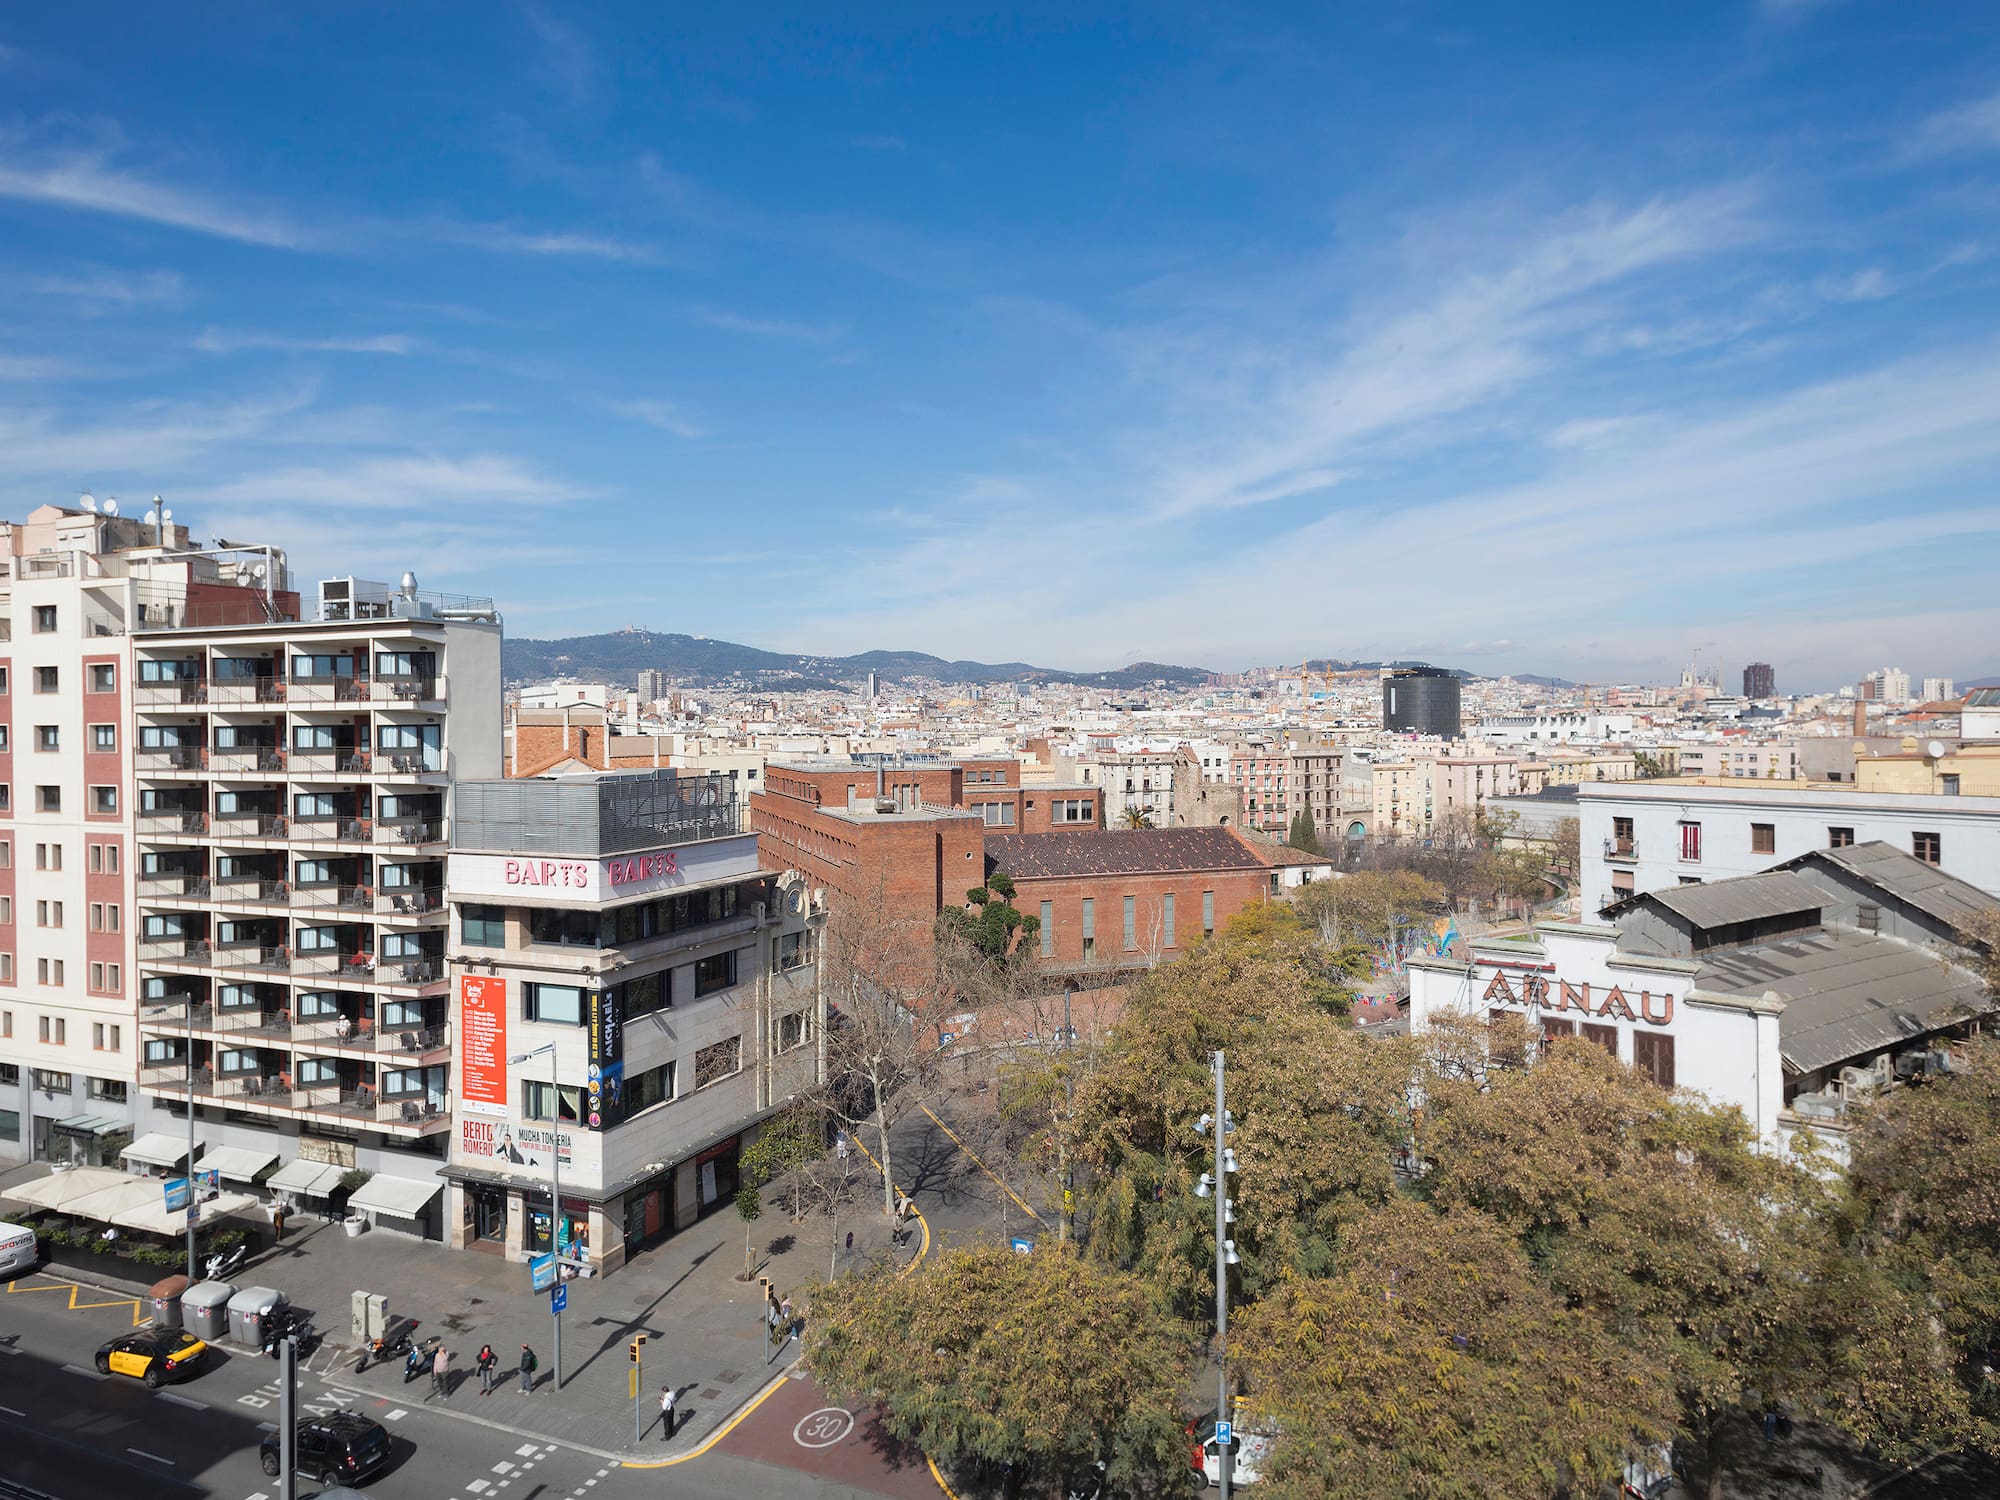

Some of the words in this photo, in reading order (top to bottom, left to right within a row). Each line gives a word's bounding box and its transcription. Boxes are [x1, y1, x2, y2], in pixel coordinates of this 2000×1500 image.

[504, 859, 588, 888] BARTS
[608, 852, 678, 887] BARTS
[1482, 969, 1674, 1026] ARNAU
[463, 1139, 493, 1157] ROMERO
[518, 1128, 540, 1144] MUCHA
[542, 1131, 571, 1148] TONERÍA
[554, 1287, 565, 1302] P
[297, 1387, 361, 1420] AXI
[806, 1416, 842, 1439] 30
[1219, 1424, 1228, 1433] P
